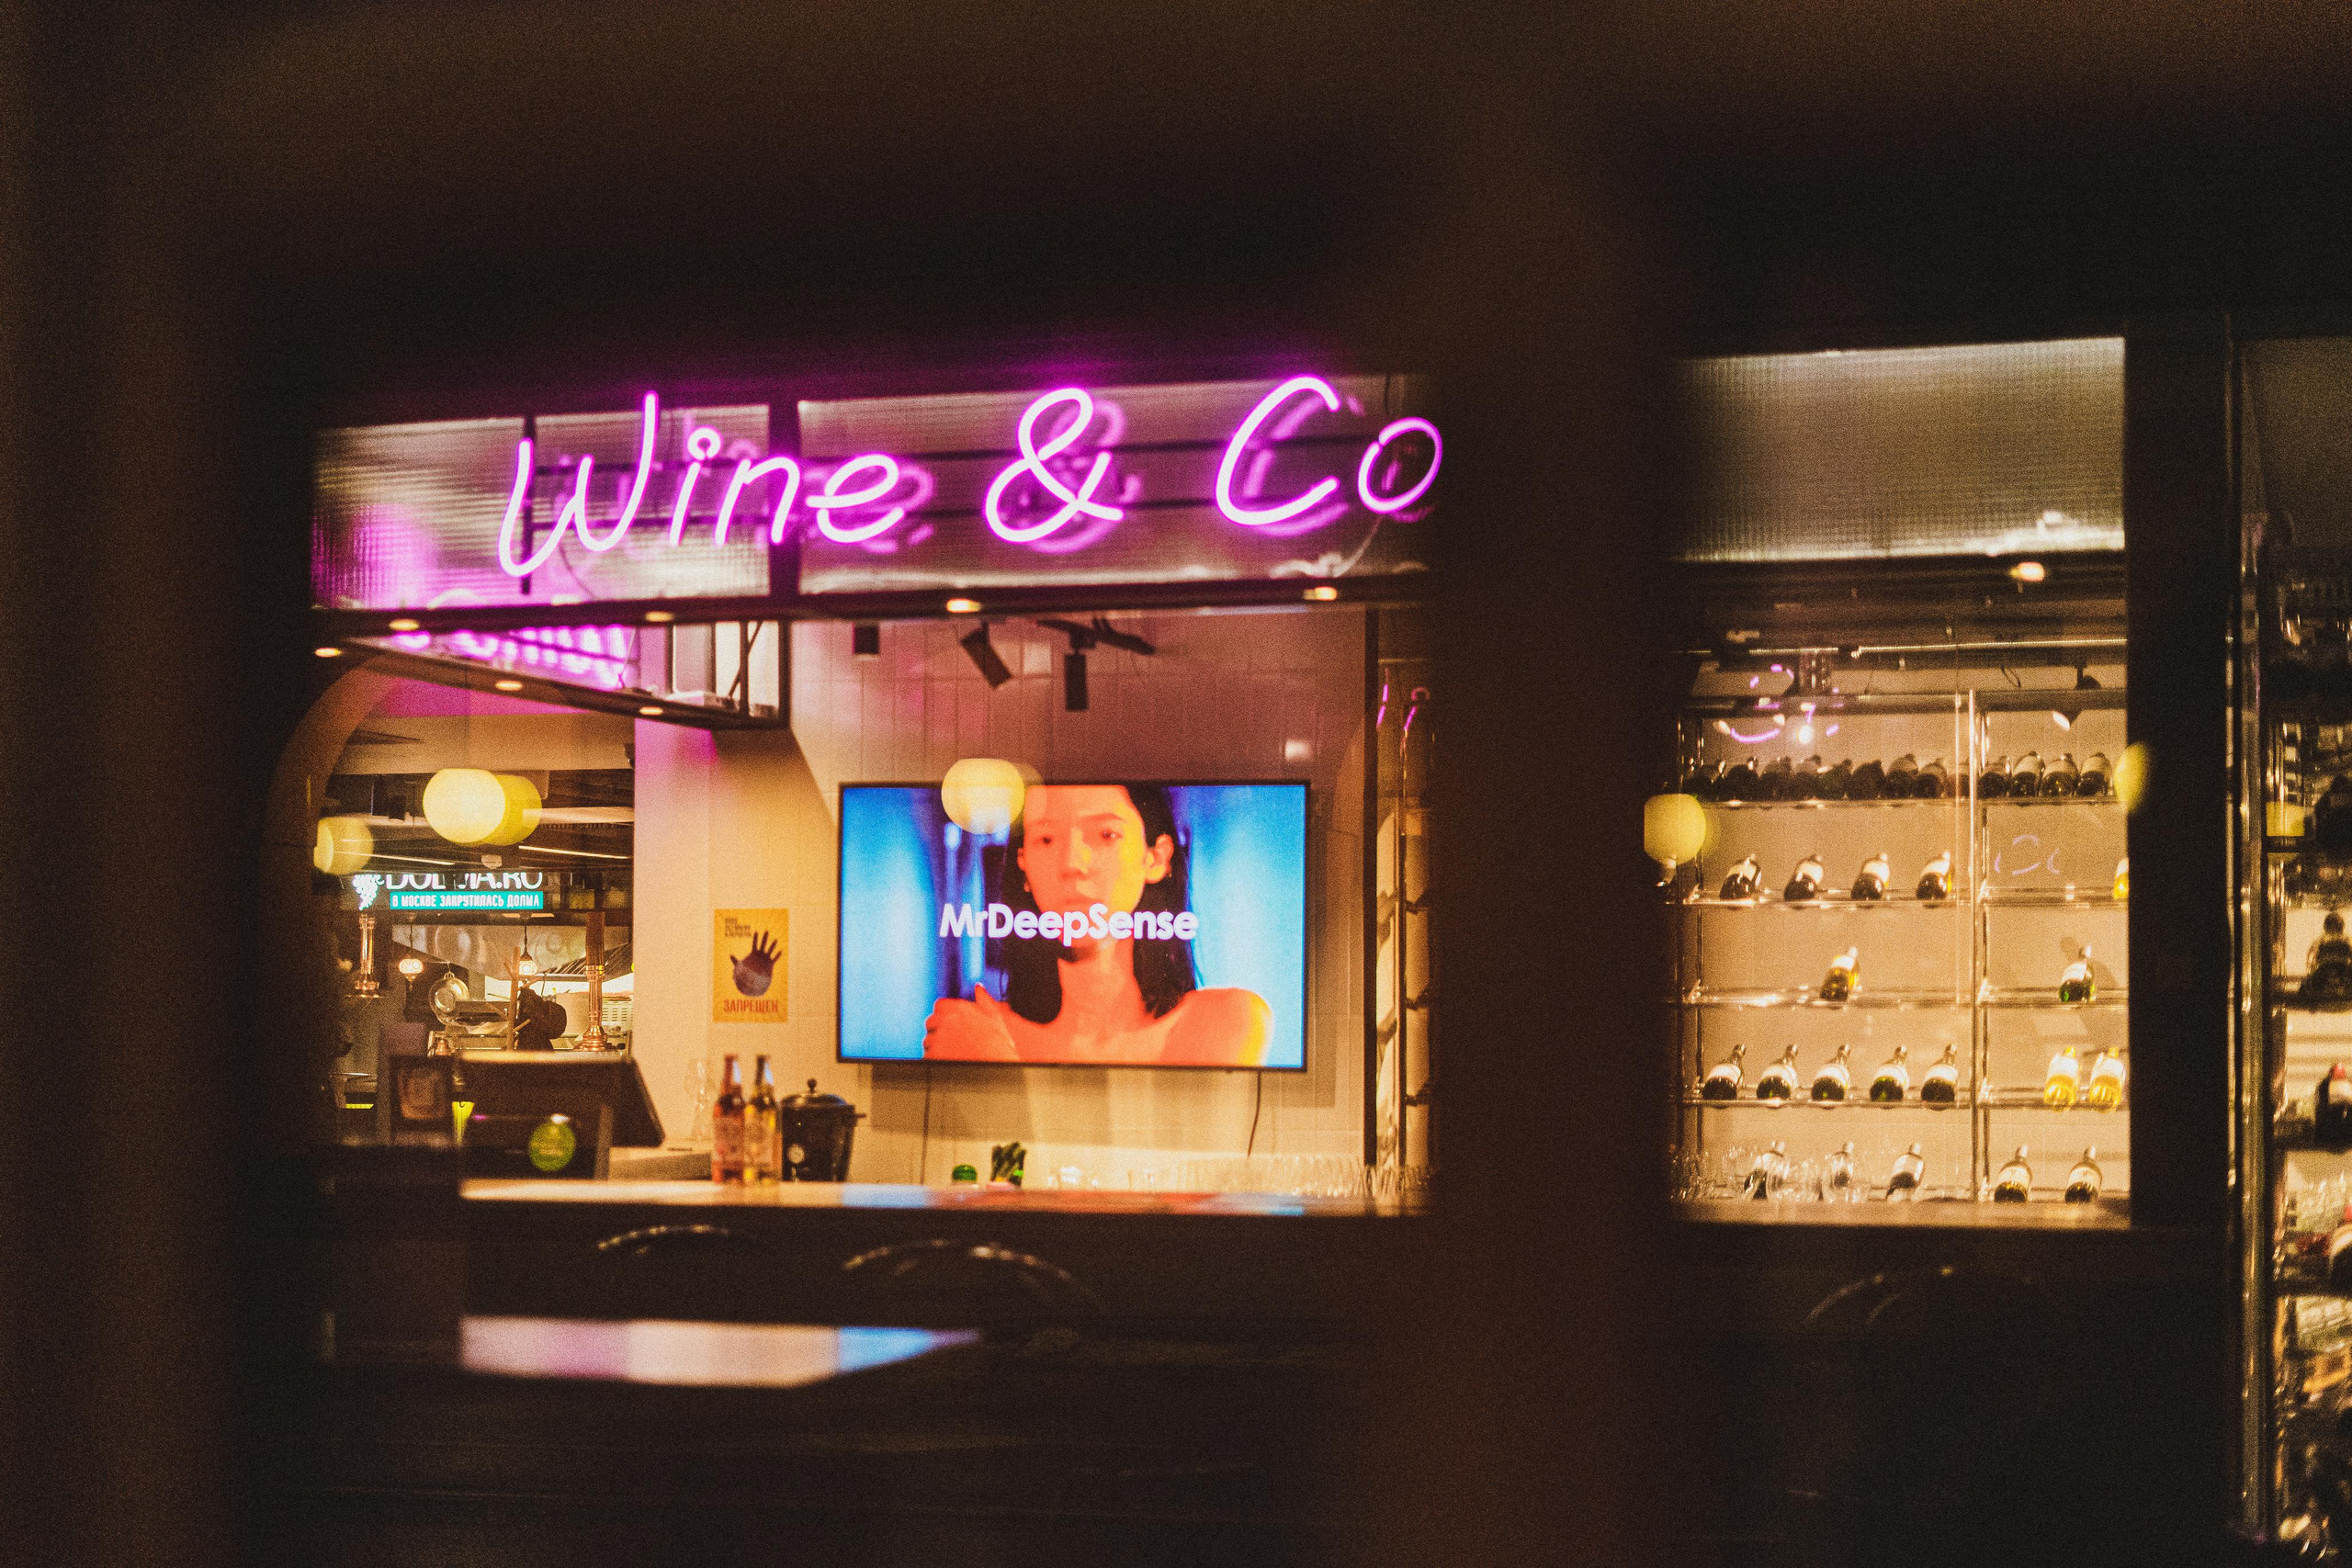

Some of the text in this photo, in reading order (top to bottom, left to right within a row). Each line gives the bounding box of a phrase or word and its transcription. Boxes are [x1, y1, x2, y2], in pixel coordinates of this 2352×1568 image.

[498, 375, 1442, 577] Wine & Co
[392, 894, 540, 908] В МОСКВЕ ЗАКРУТИЛАСЬ ДОЛМА
[939, 902, 1199, 947] MrDeepSense
